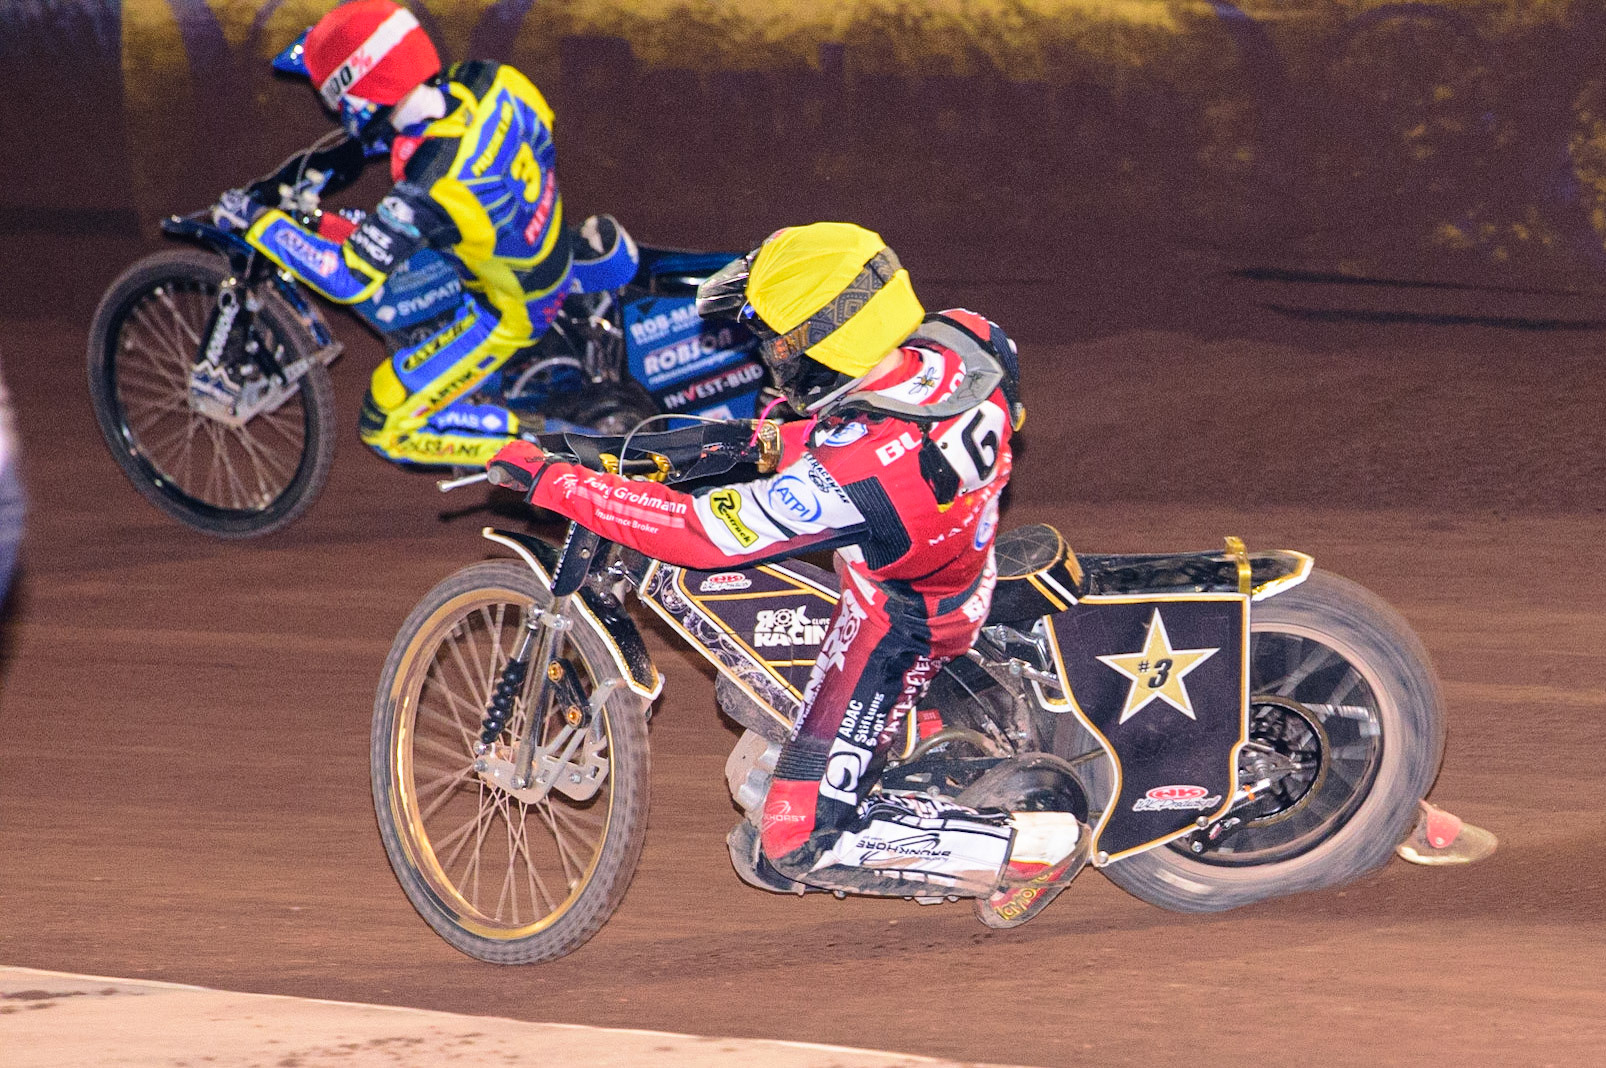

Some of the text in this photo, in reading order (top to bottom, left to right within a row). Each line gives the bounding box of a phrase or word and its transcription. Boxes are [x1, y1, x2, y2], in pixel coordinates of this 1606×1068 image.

[664, 363, 763, 410] INVEST-BUD
[614, 486, 688, 514] Grohmann
[776, 487, 810, 518] ATPI
[631, 519, 659, 535] Broker
[714, 492, 751, 543] Rentruck
[838, 699, 864, 739] ADAC
[866, 713, 887, 747] Sort
